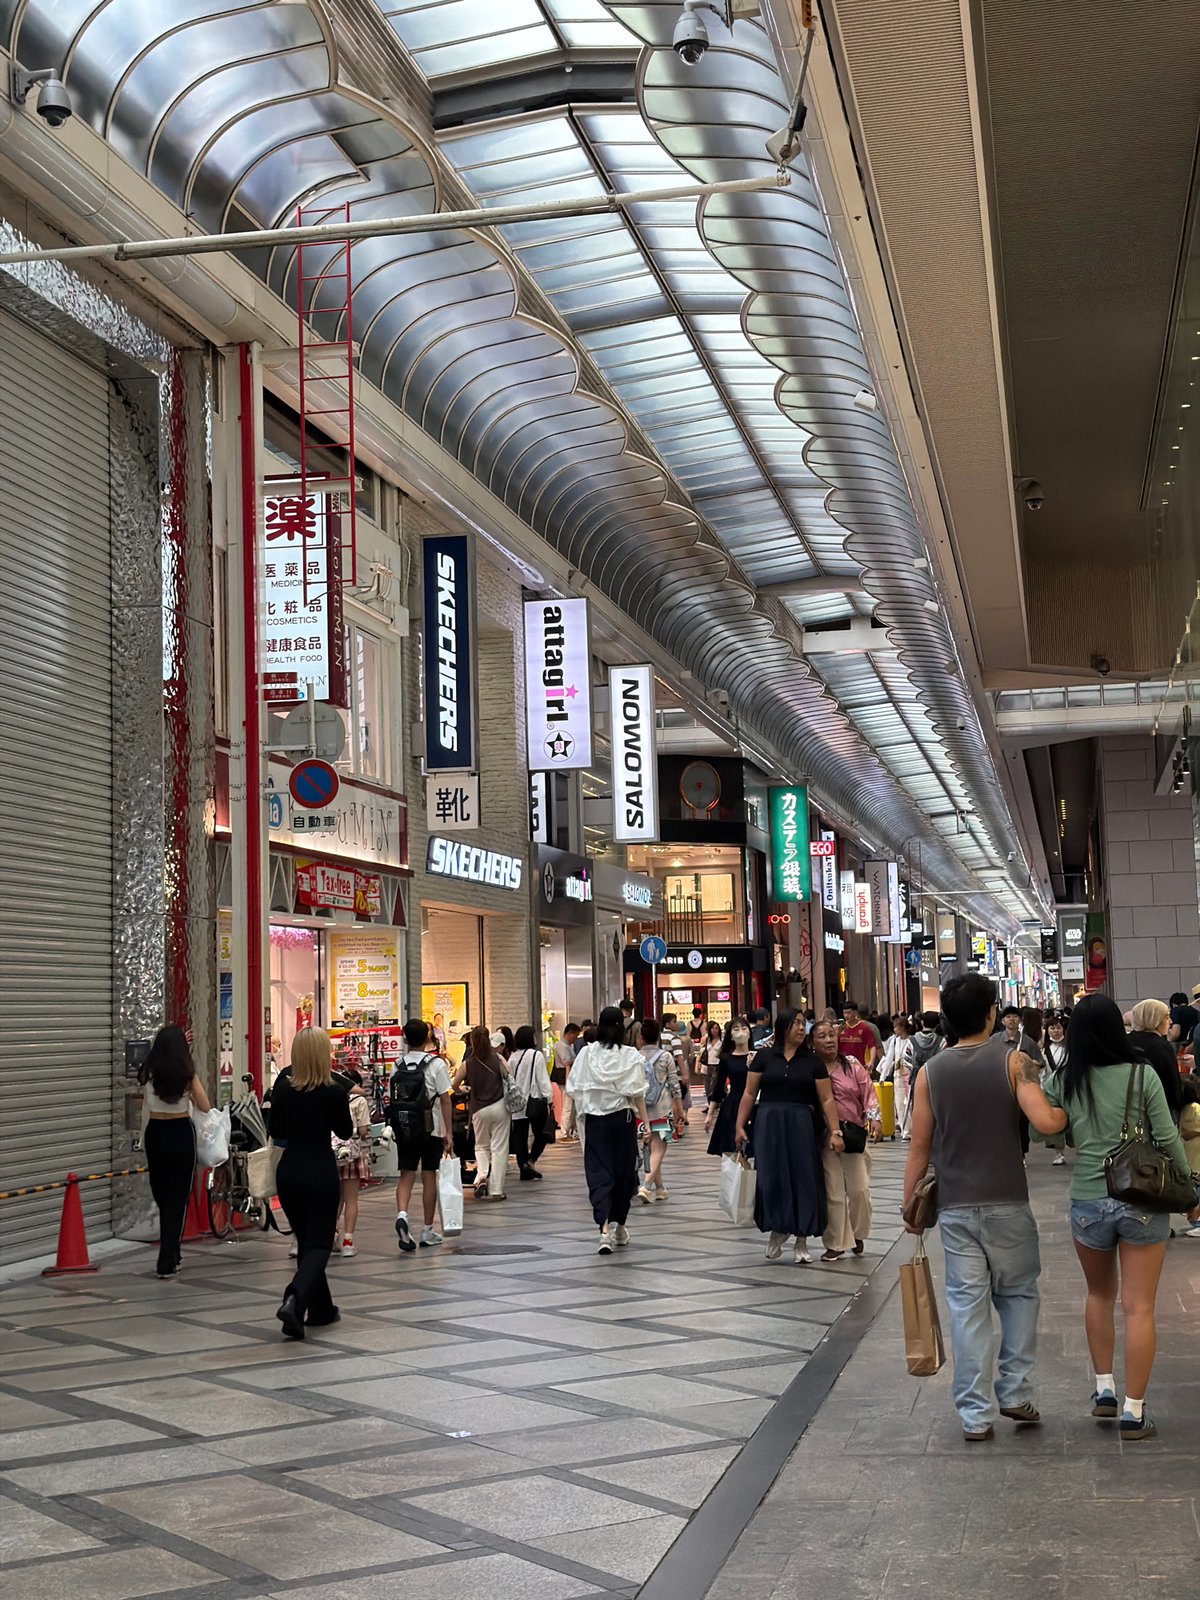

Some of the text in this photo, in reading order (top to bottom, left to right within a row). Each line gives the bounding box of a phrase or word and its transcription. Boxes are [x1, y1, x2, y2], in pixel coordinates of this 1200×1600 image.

[271, 579, 312, 588] MEDICIN
[266, 616, 318, 626] COSMETICS
[301, 655, 323, 663] FOOD
[437, 552, 458, 752] SKECHERS
[542, 605, 571, 722] attagirl
[622, 679, 644, 830] SALOMON
[293, 815, 336, 829] 自動車
[435, 788, 471, 823] 靴
[430, 837, 522, 889] SKECHERS
[565, 868, 593, 902] attagirl
[841, 883, 854, 918] 福原
[857, 891, 870, 928] graniph
[705, 956, 727, 964] MIKI
